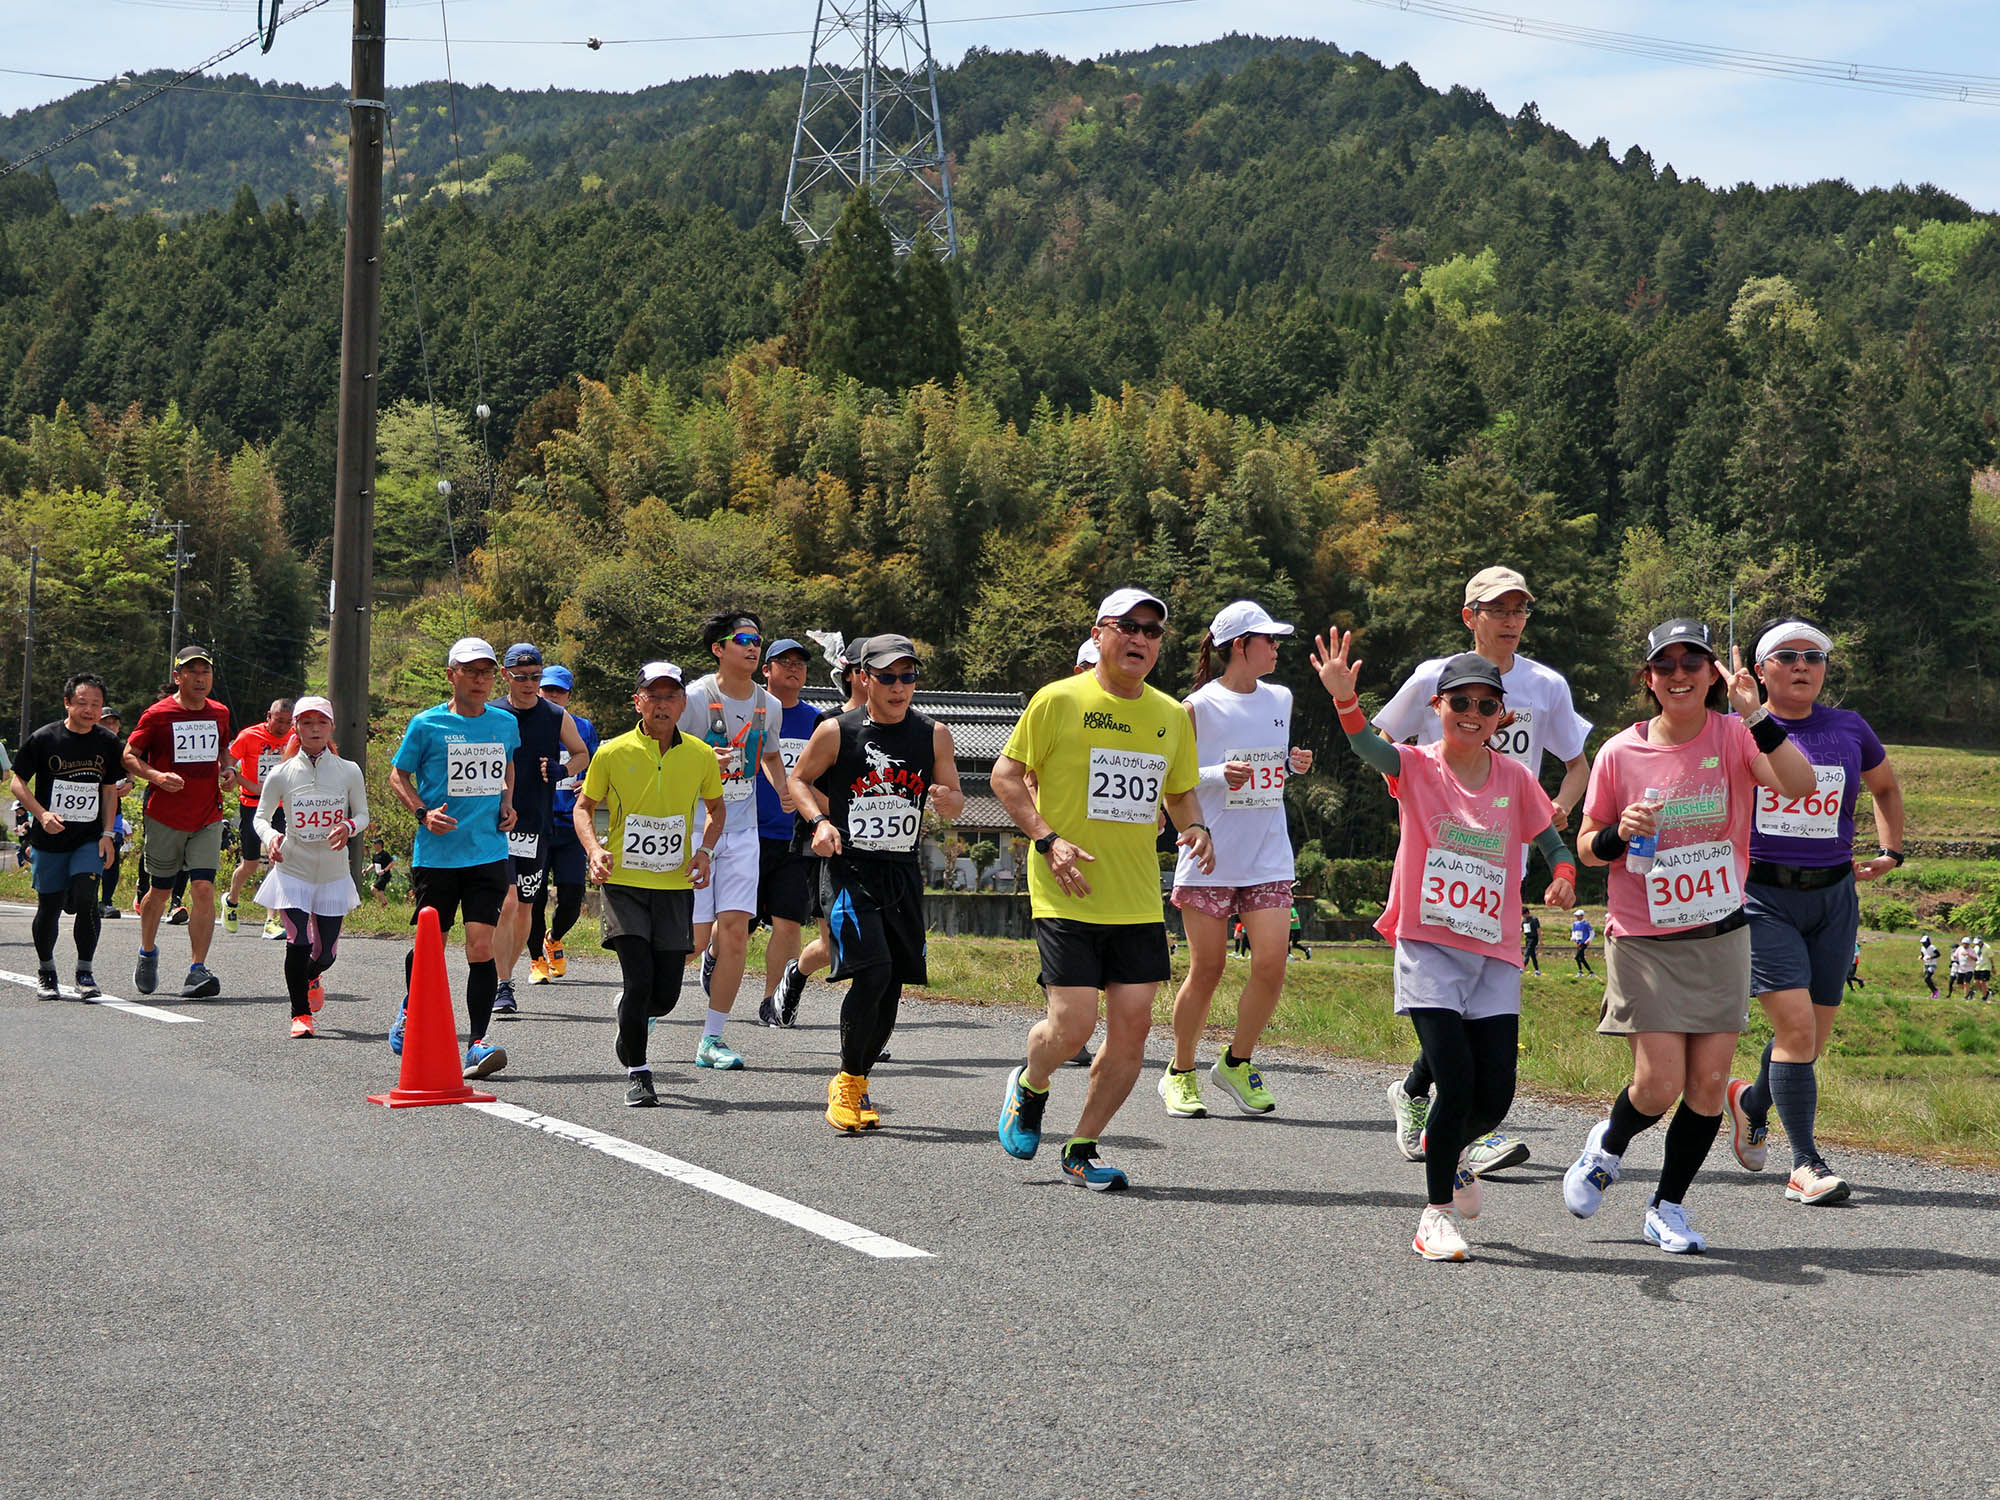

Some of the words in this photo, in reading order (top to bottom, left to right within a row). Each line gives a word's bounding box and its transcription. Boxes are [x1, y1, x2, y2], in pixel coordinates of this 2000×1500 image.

[1084, 712, 1112, 721] MOVE
[177, 734, 217, 750] 2117
[451, 760, 504, 780] 2618
[784, 752, 802, 768] 2
[1109, 755, 1166, 772] JAひがしみの
[1092, 772, 1159, 803] 2303
[1229, 766, 1284, 791] 135
[55, 793, 97, 811] 1897
[1761, 787, 1840, 817] 3266
[294, 809, 345, 829] 3458
[852, 815, 917, 839] 2350
[626, 832, 683, 856] 2639
[1447, 829, 1500, 850] FINISHER
[1667, 845, 1732, 868] JAひがしみの
[1651, 865, 1731, 907] 3041
[1425, 876, 1502, 921] 3042
